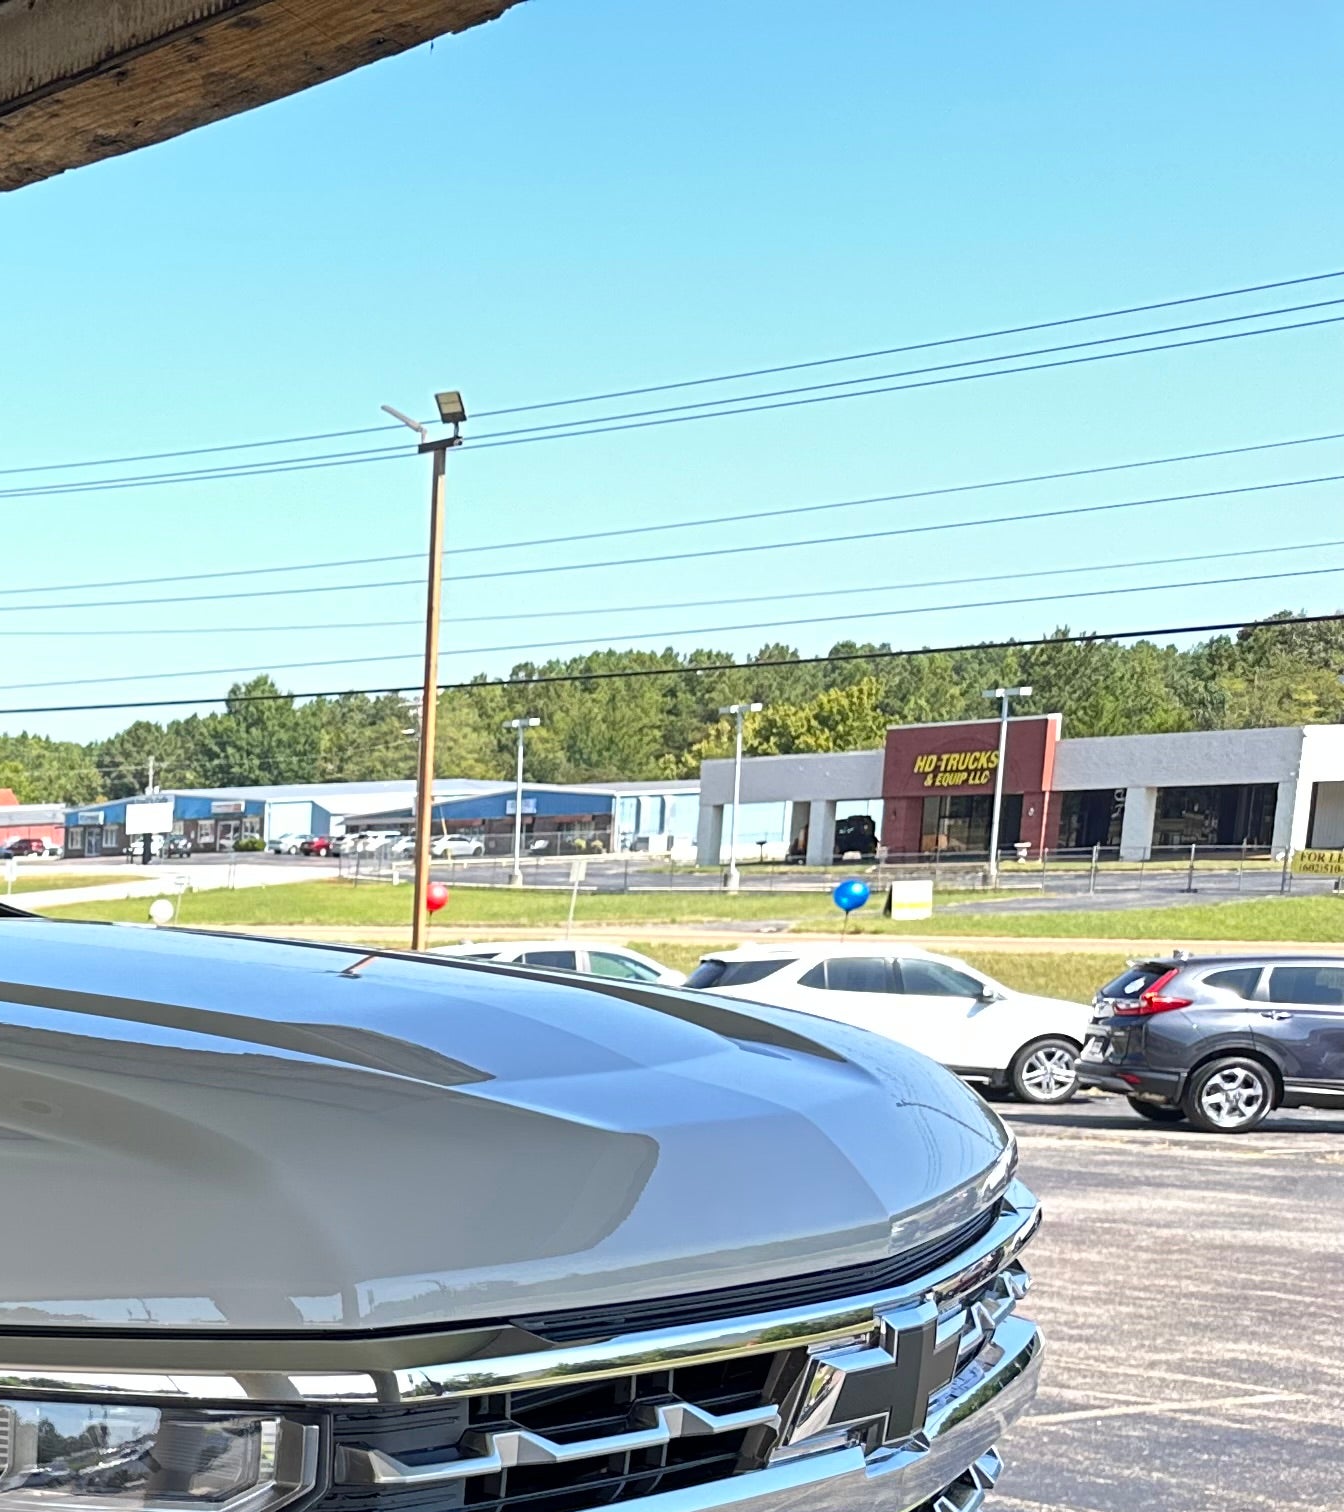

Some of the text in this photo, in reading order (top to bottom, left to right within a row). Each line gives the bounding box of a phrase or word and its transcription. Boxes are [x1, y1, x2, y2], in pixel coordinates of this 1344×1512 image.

[923, 770, 991, 787] & EQUIP LLC
[1300, 851, 1325, 863] FOR
